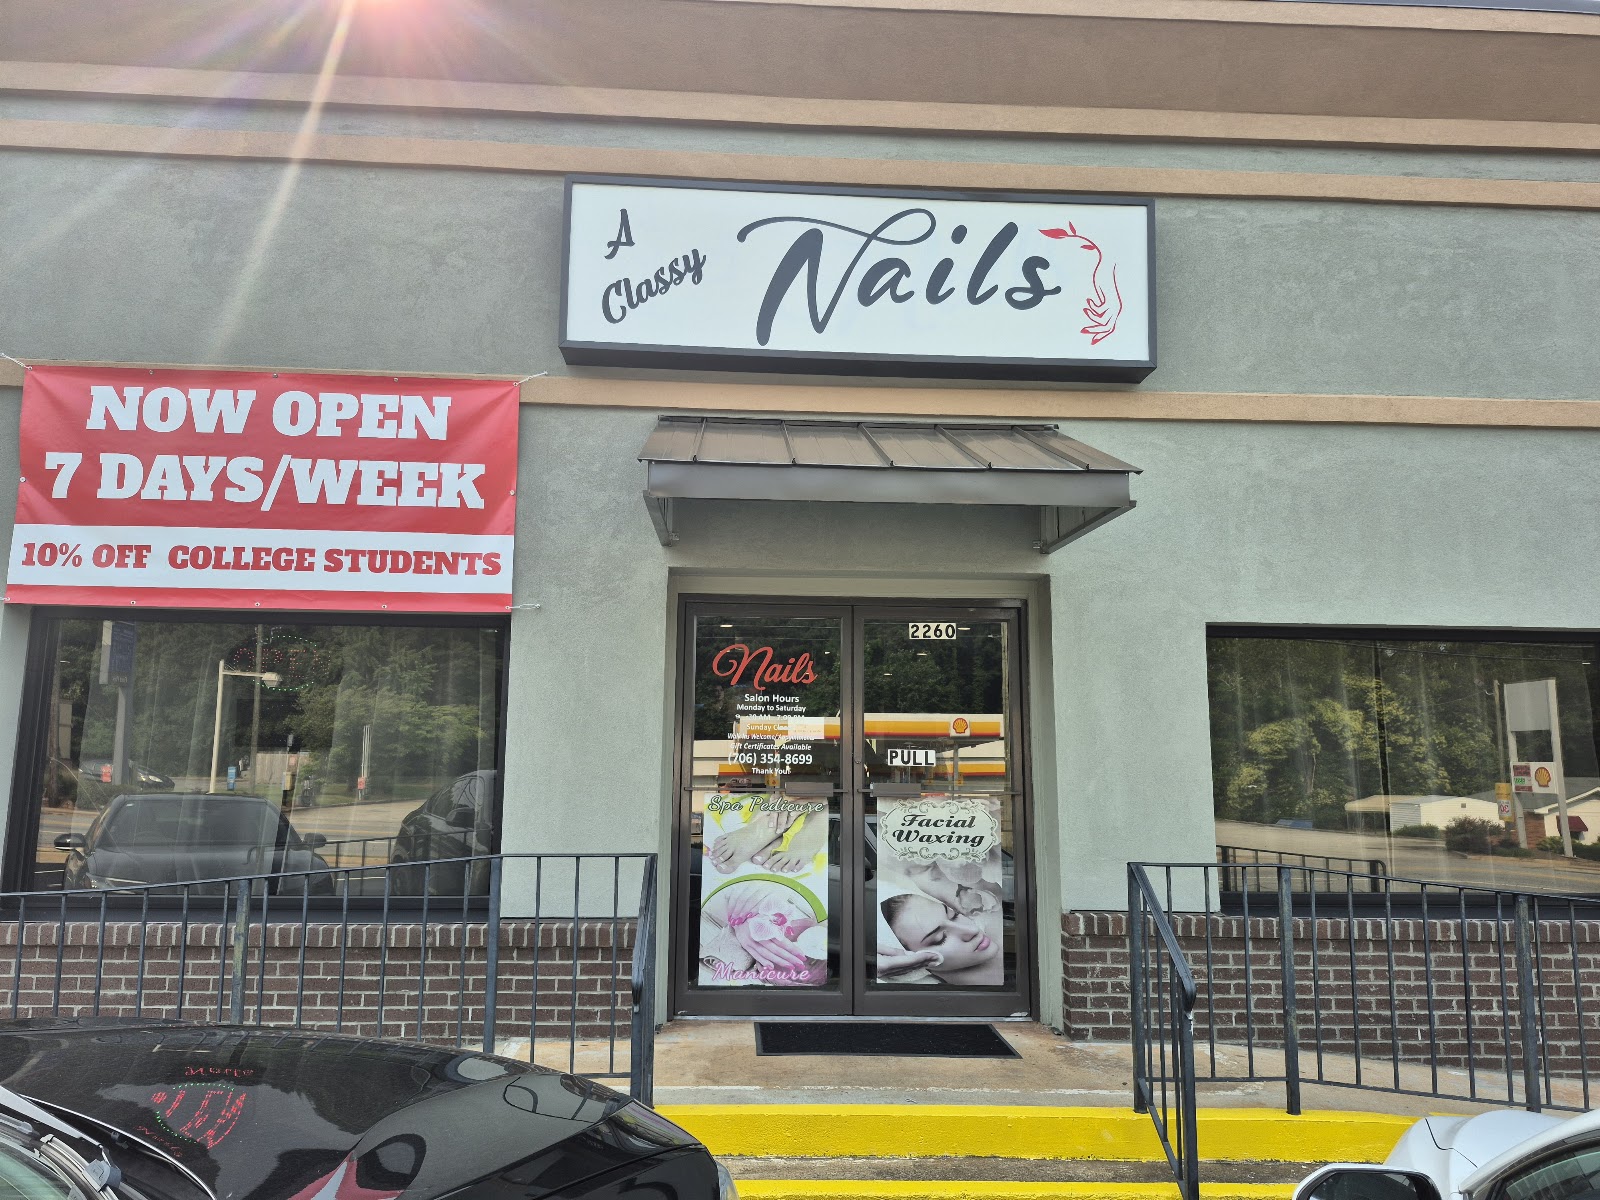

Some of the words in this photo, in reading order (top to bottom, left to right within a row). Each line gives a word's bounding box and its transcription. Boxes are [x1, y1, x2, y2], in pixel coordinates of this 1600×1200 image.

[604, 208, 635, 260] A
[601, 247, 707, 324] Classy
[737, 207, 1062, 346] Nails
[86, 385, 257, 434] NOW
[271, 390, 452, 441] OPEN
[44, 451, 83, 499] 7
[97, 452, 486, 512] DAYS/WEEK
[21, 542, 83, 568] 10%
[92, 544, 152, 569] OFF
[168, 545, 316, 573] COLLEGE
[323, 548, 502, 576] STUDENTS
[910, 623, 956, 639] 2260
[712, 643, 818, 691] Nails
[744, 693, 770, 703] Salon
[772, 694, 800, 703] Hours
[736, 703, 766, 712] Monday
[775, 704, 807, 713] Saturday
[746, 723, 772, 731] Sunday
[730, 742, 743, 750] Gift
[743, 742, 780, 751] Certificates
[780, 743, 812, 751] Available
[727, 752, 757, 766] (706)
[760, 753, 813, 765] 354-8699
[889, 749, 935, 766] PULL
[751, 767, 774, 775] Thank
[708, 794, 743, 814] Spa
[749, 795, 825, 812] Pedicure
[900, 814, 976, 828] Facial
[892, 829, 985, 847] Waxing
[711, 961, 811, 981] Manicure
